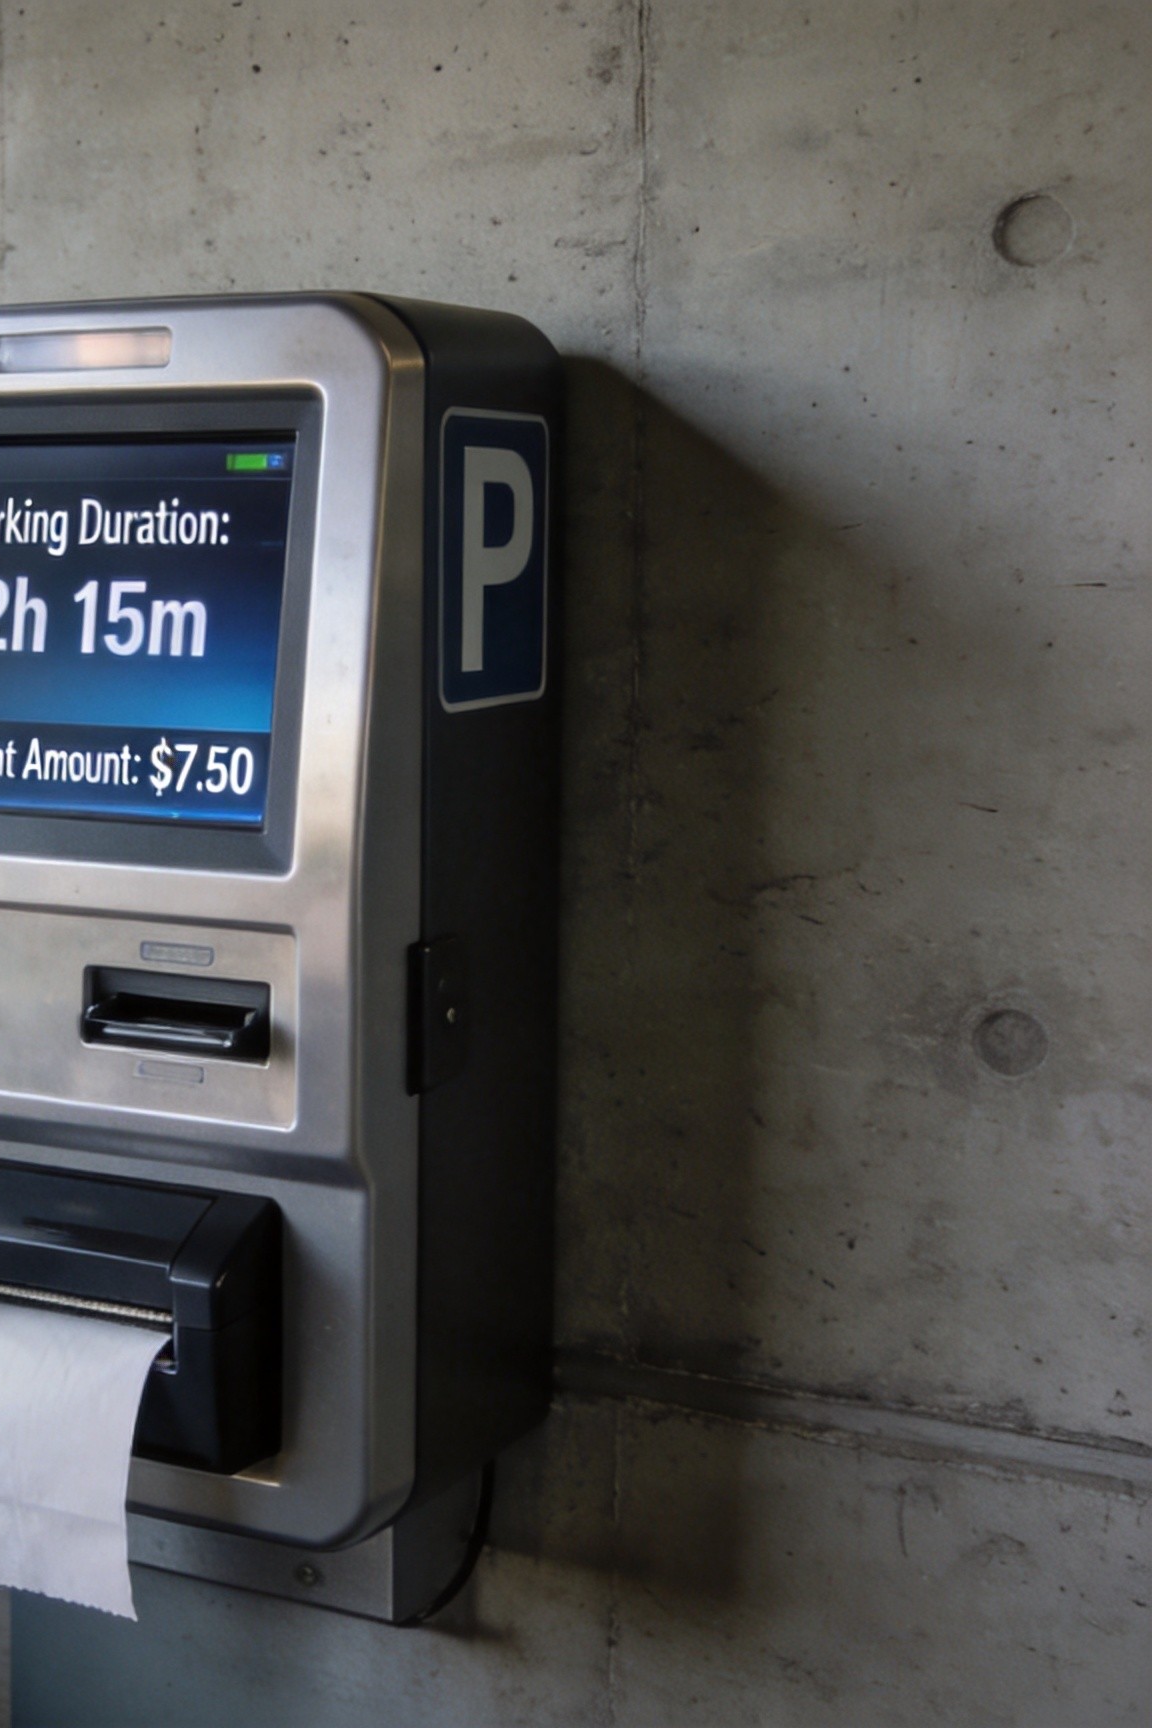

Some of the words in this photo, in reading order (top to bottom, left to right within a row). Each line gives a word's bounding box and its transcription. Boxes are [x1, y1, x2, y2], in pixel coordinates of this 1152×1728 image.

[77, 497, 231, 546] Duration:
[461, 445, 534, 672] P
[73, 579, 208, 657] 15m
[21, 737, 142, 785] Amount:
[148, 736, 255, 797] $7.50
